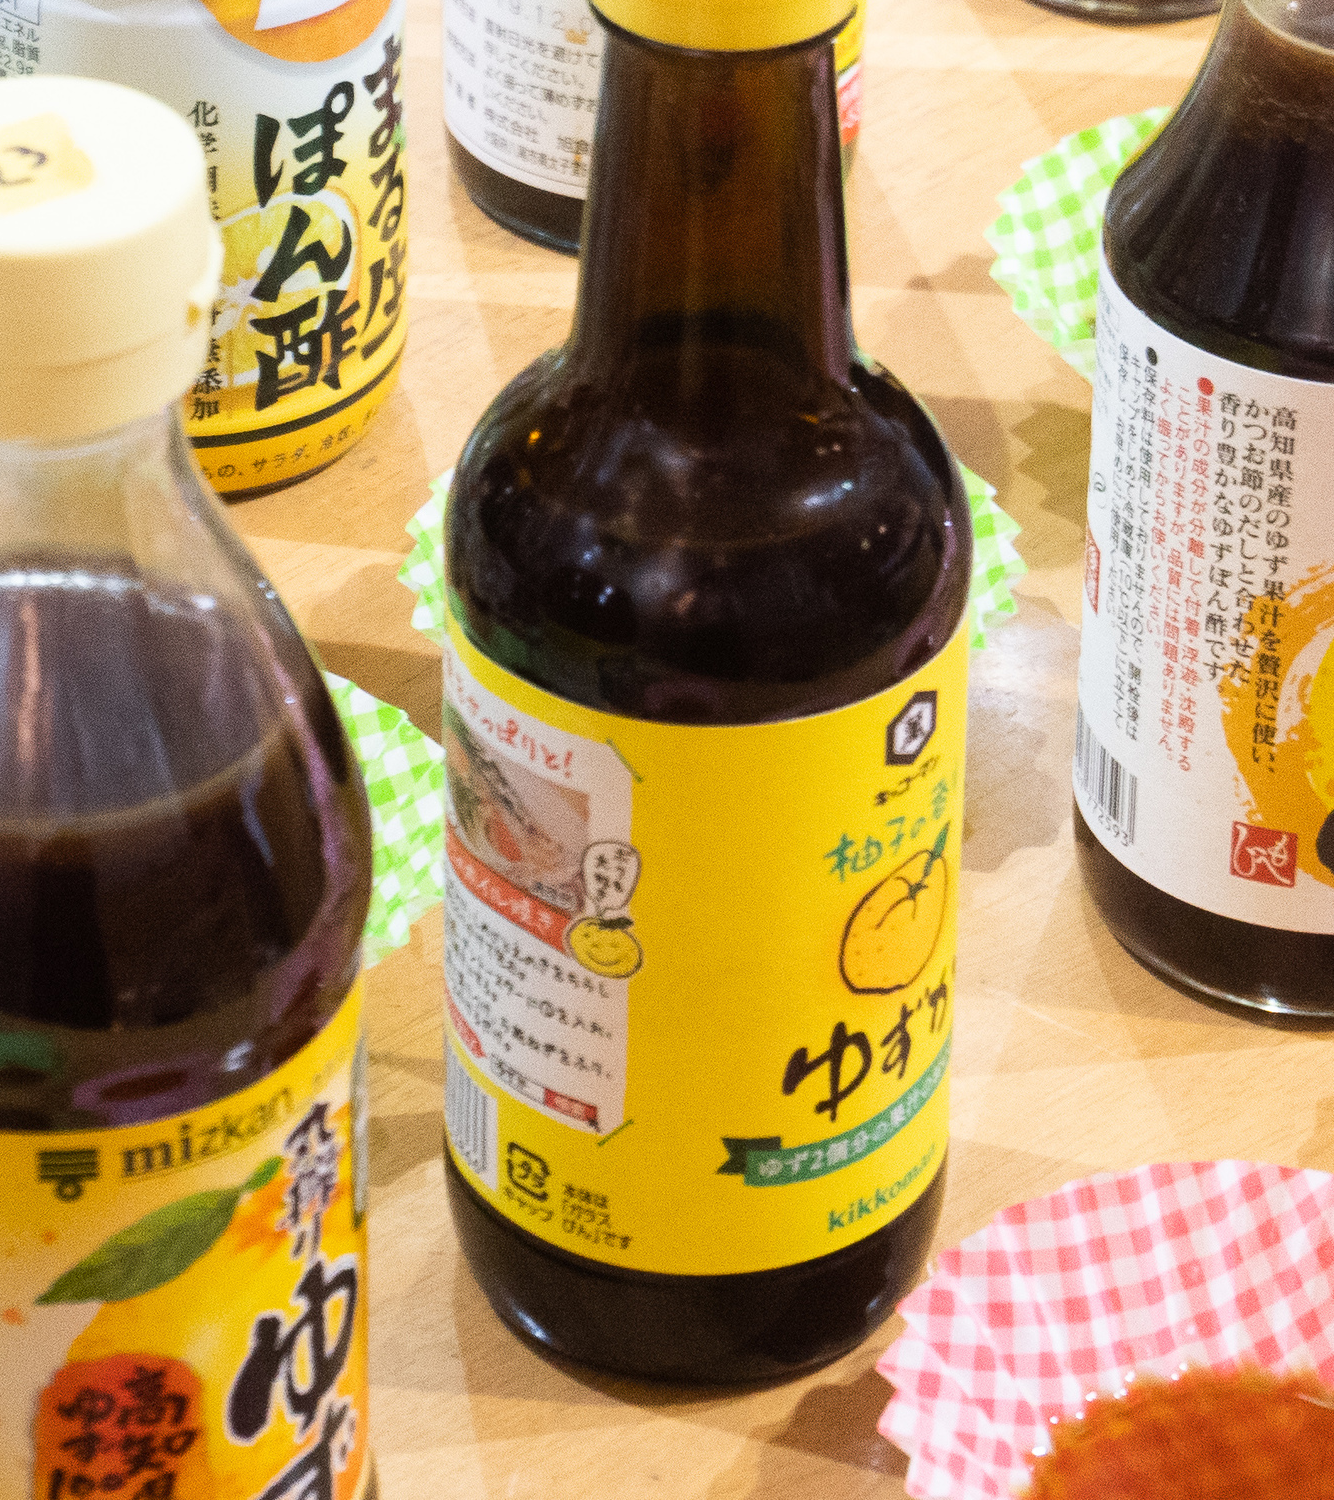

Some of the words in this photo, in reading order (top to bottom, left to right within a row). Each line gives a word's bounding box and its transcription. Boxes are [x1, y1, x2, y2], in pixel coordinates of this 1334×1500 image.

[250, 81, 360, 411] ぽん酢
[1204, 391, 1242, 695] 香り豊かなゆずぽん酢です。
[1229, 398, 1271, 686] かつお節のだしと合わせた
[120, 1085, 296, 1183] mizkan
